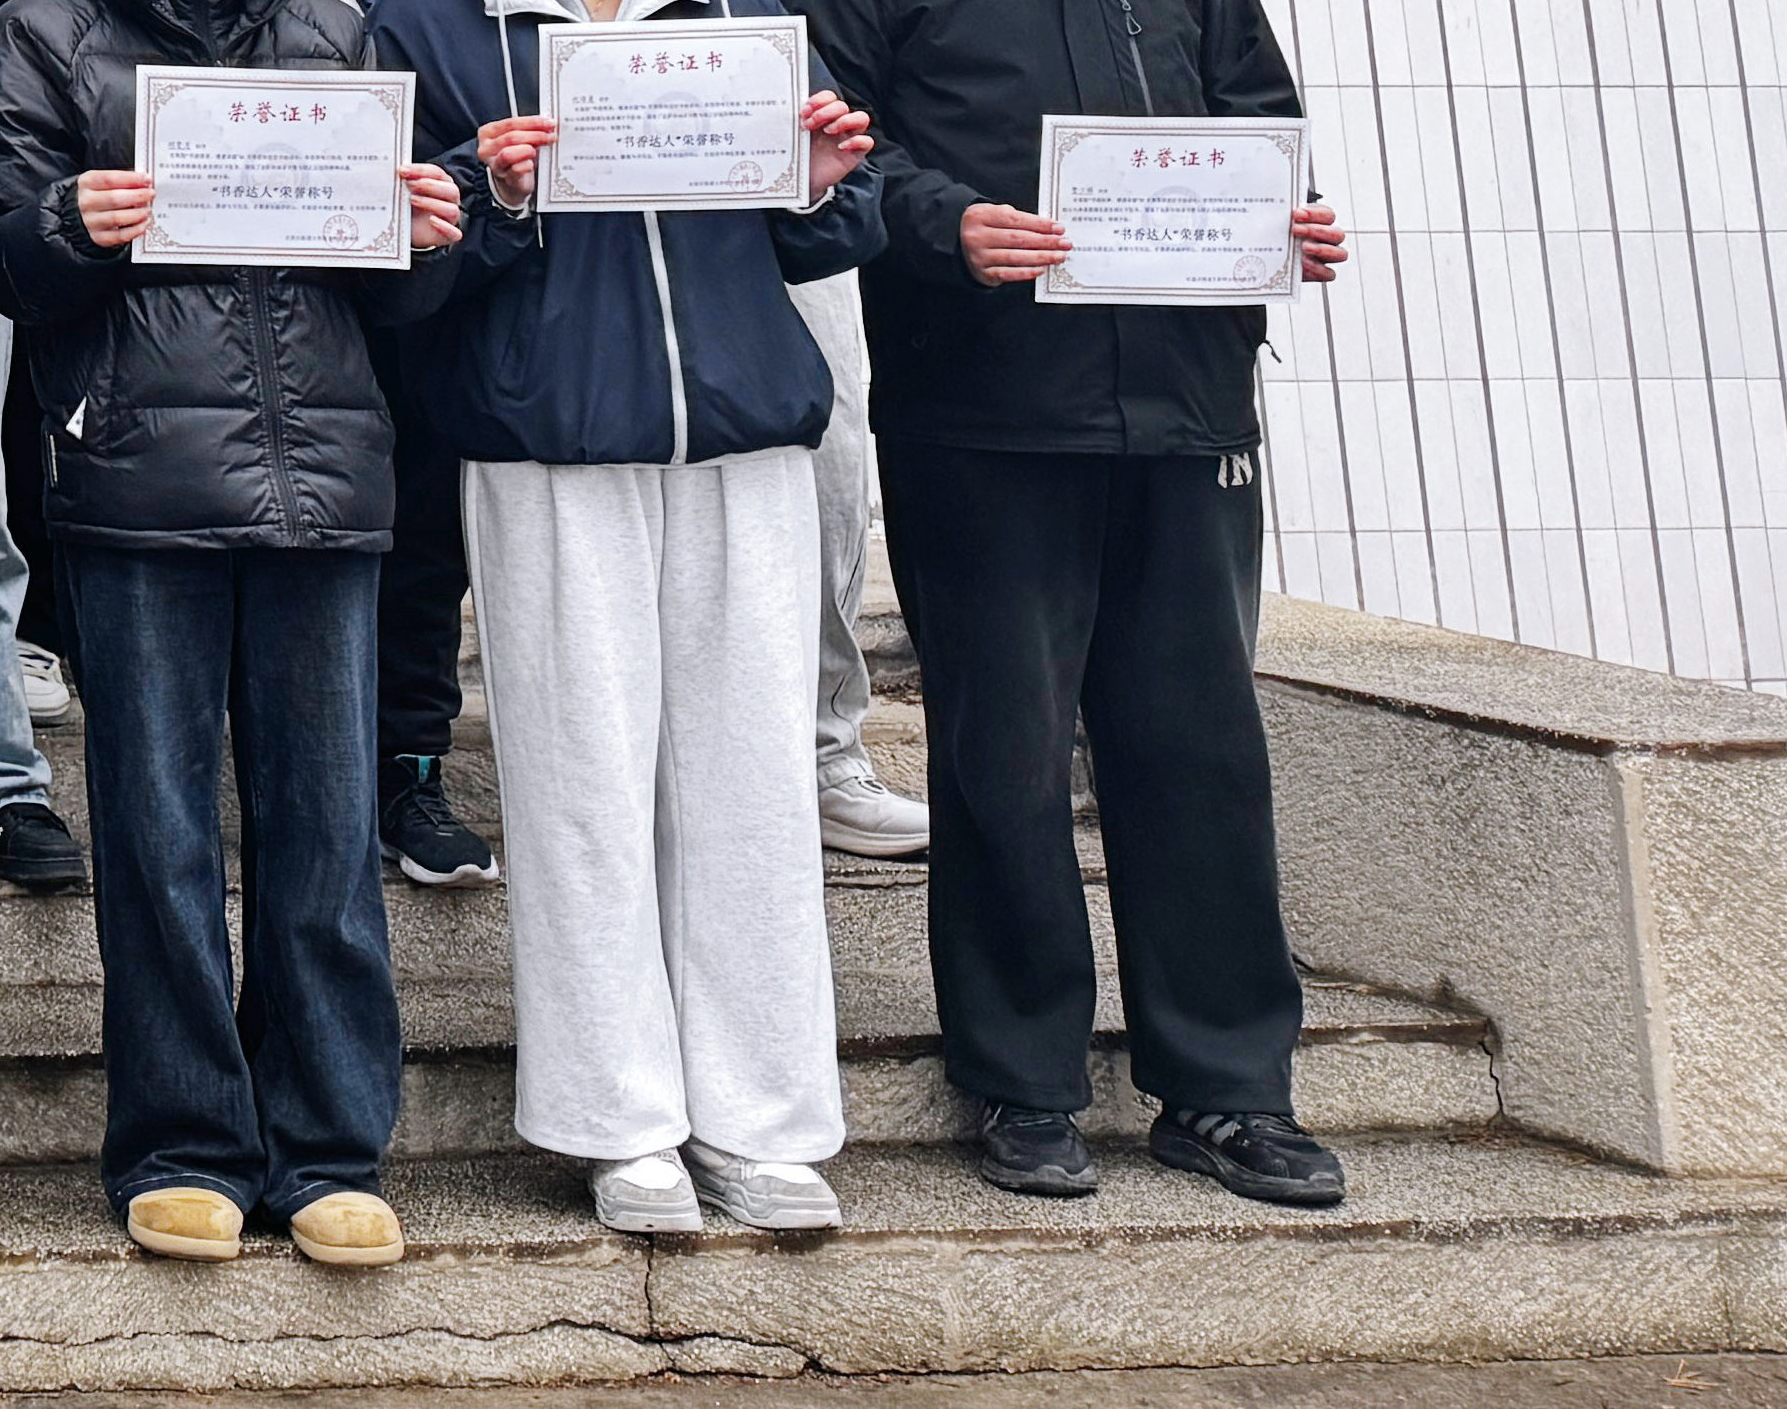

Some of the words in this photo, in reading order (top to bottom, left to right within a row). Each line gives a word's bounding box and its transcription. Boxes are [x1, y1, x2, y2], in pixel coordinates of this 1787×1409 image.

[628, 51, 724, 74] 荣誉证书
[229, 101, 328, 125] 荣誉证书
[1131, 147, 1227, 169] 荣誉证书
